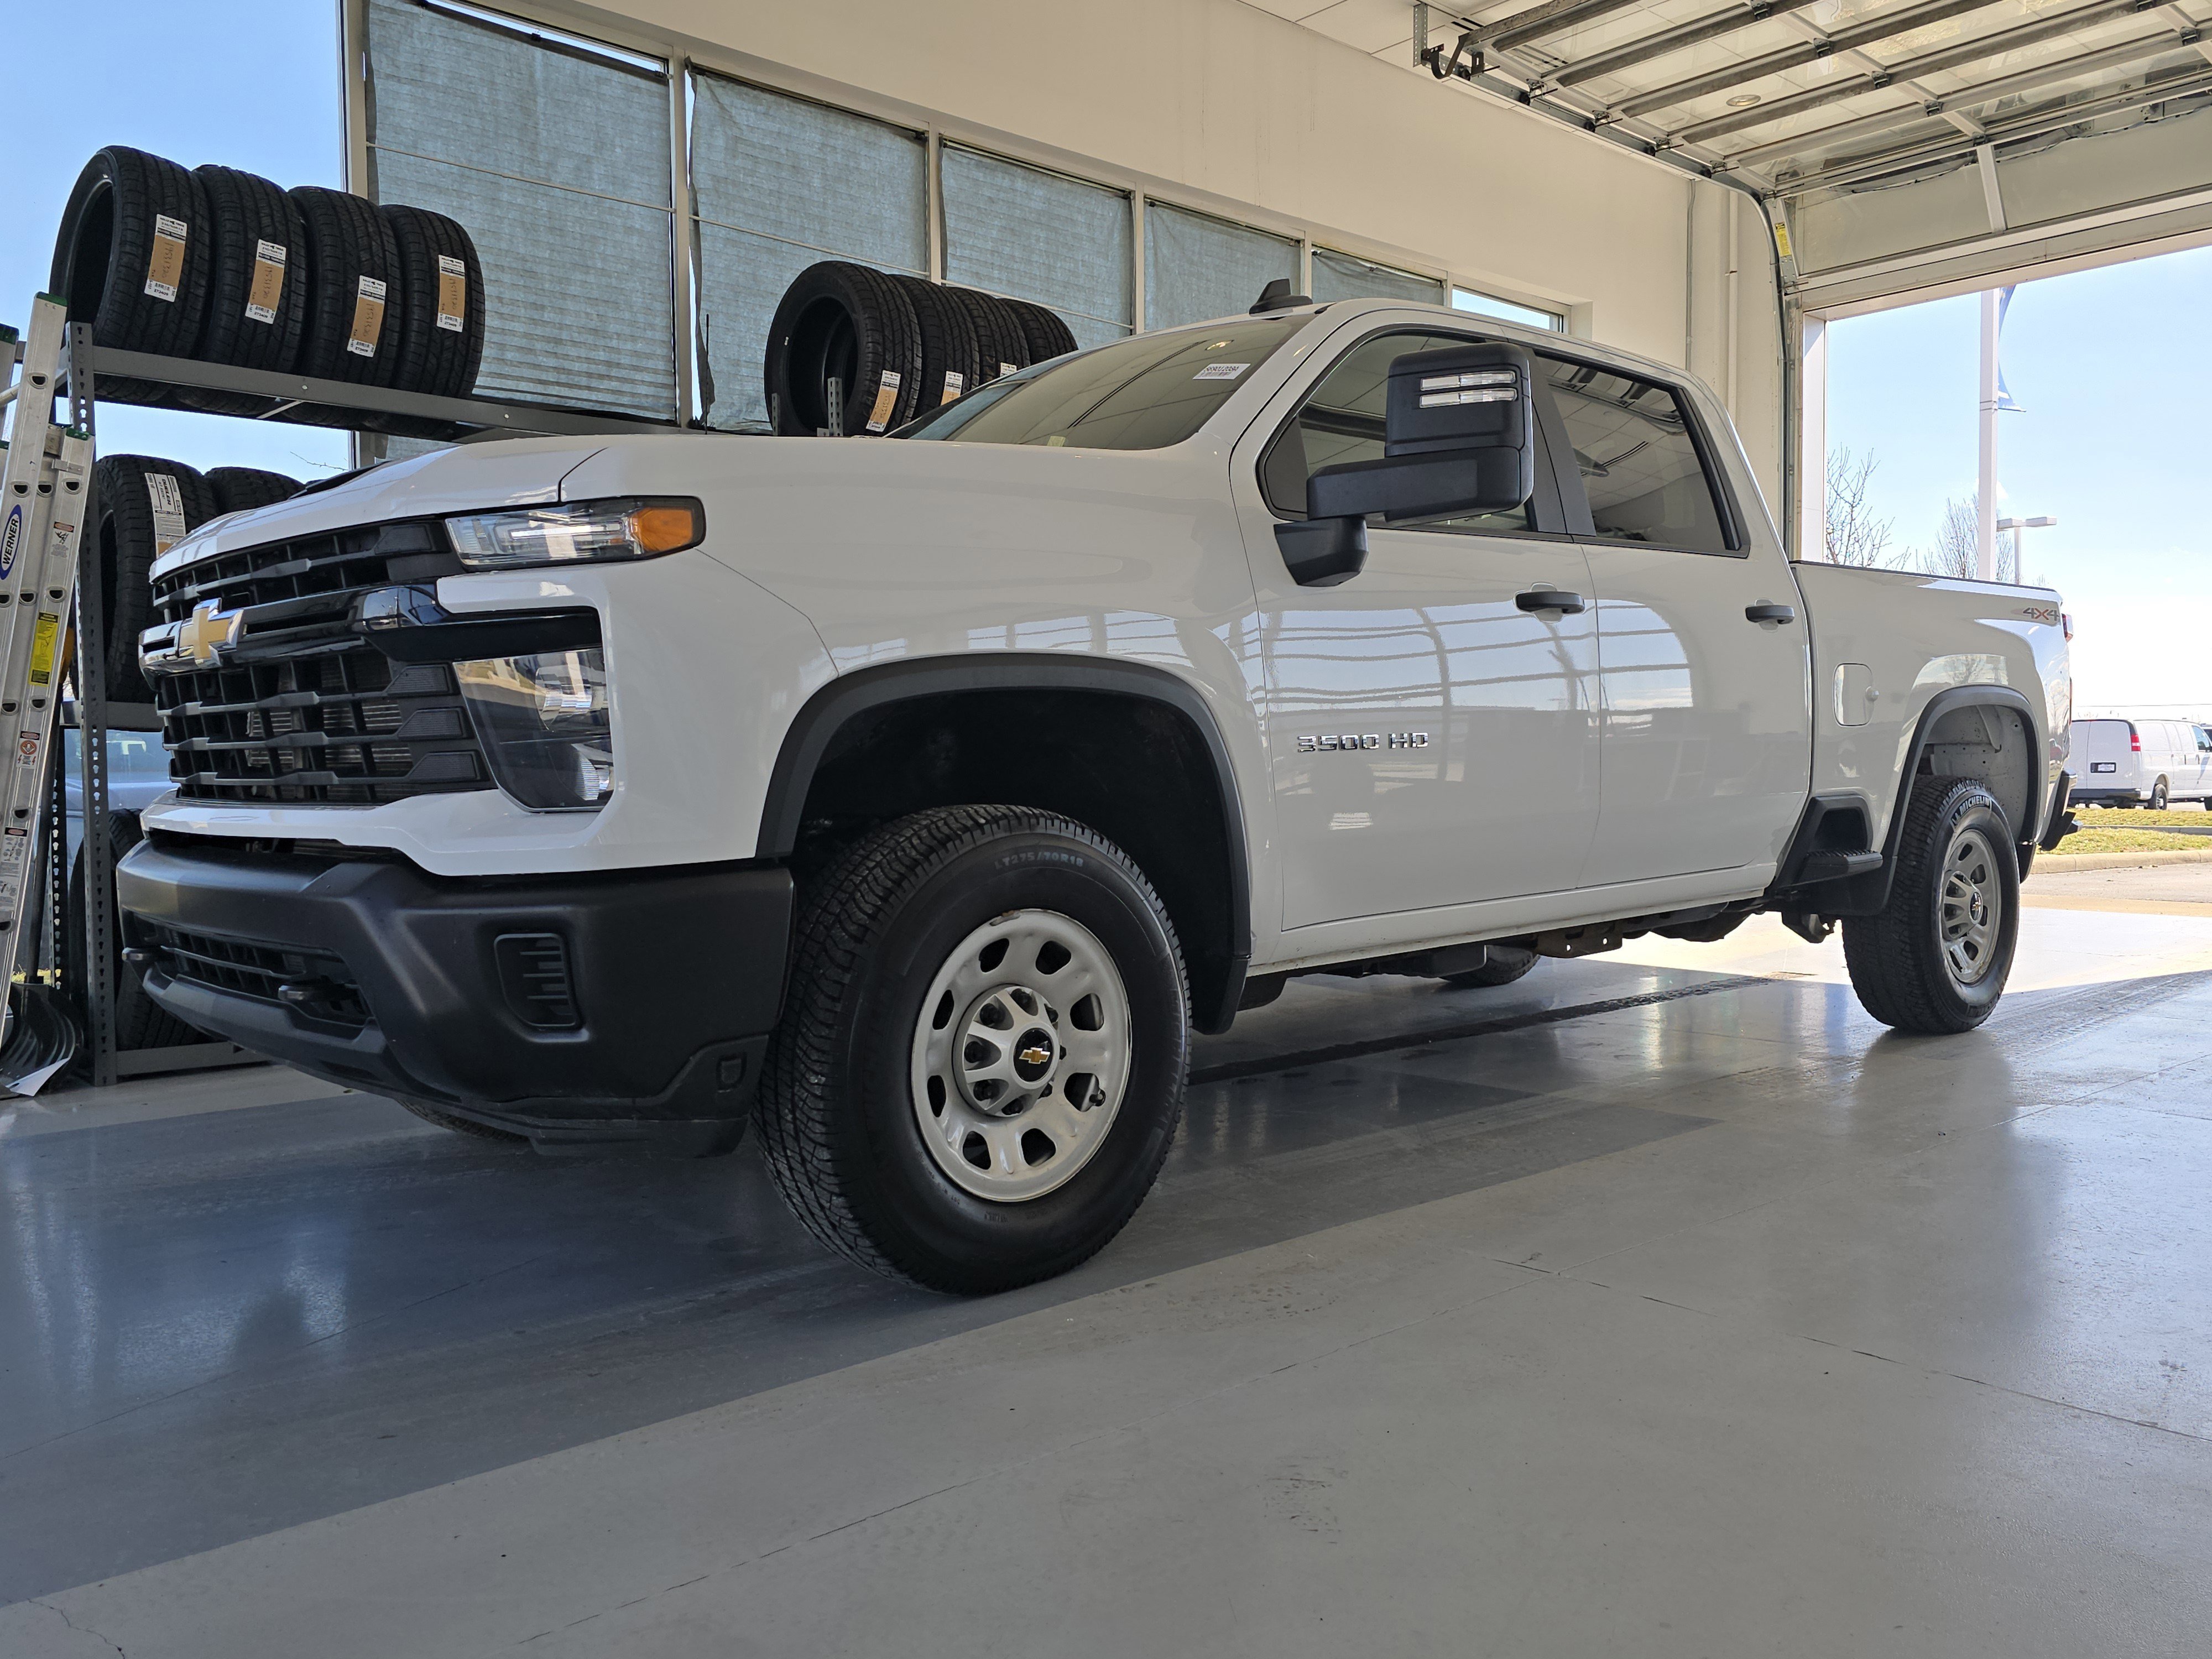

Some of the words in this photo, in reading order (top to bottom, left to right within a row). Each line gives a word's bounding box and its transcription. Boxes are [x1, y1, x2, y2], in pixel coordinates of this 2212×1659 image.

[2, 518, 18, 565] WERNER
[1298, 734, 1380, 753] 3500
[1388, 732, 1428, 749] HD
[1959, 796, 1990, 816] MICHELIN
[994, 852, 1084, 869] LT275/70R18
